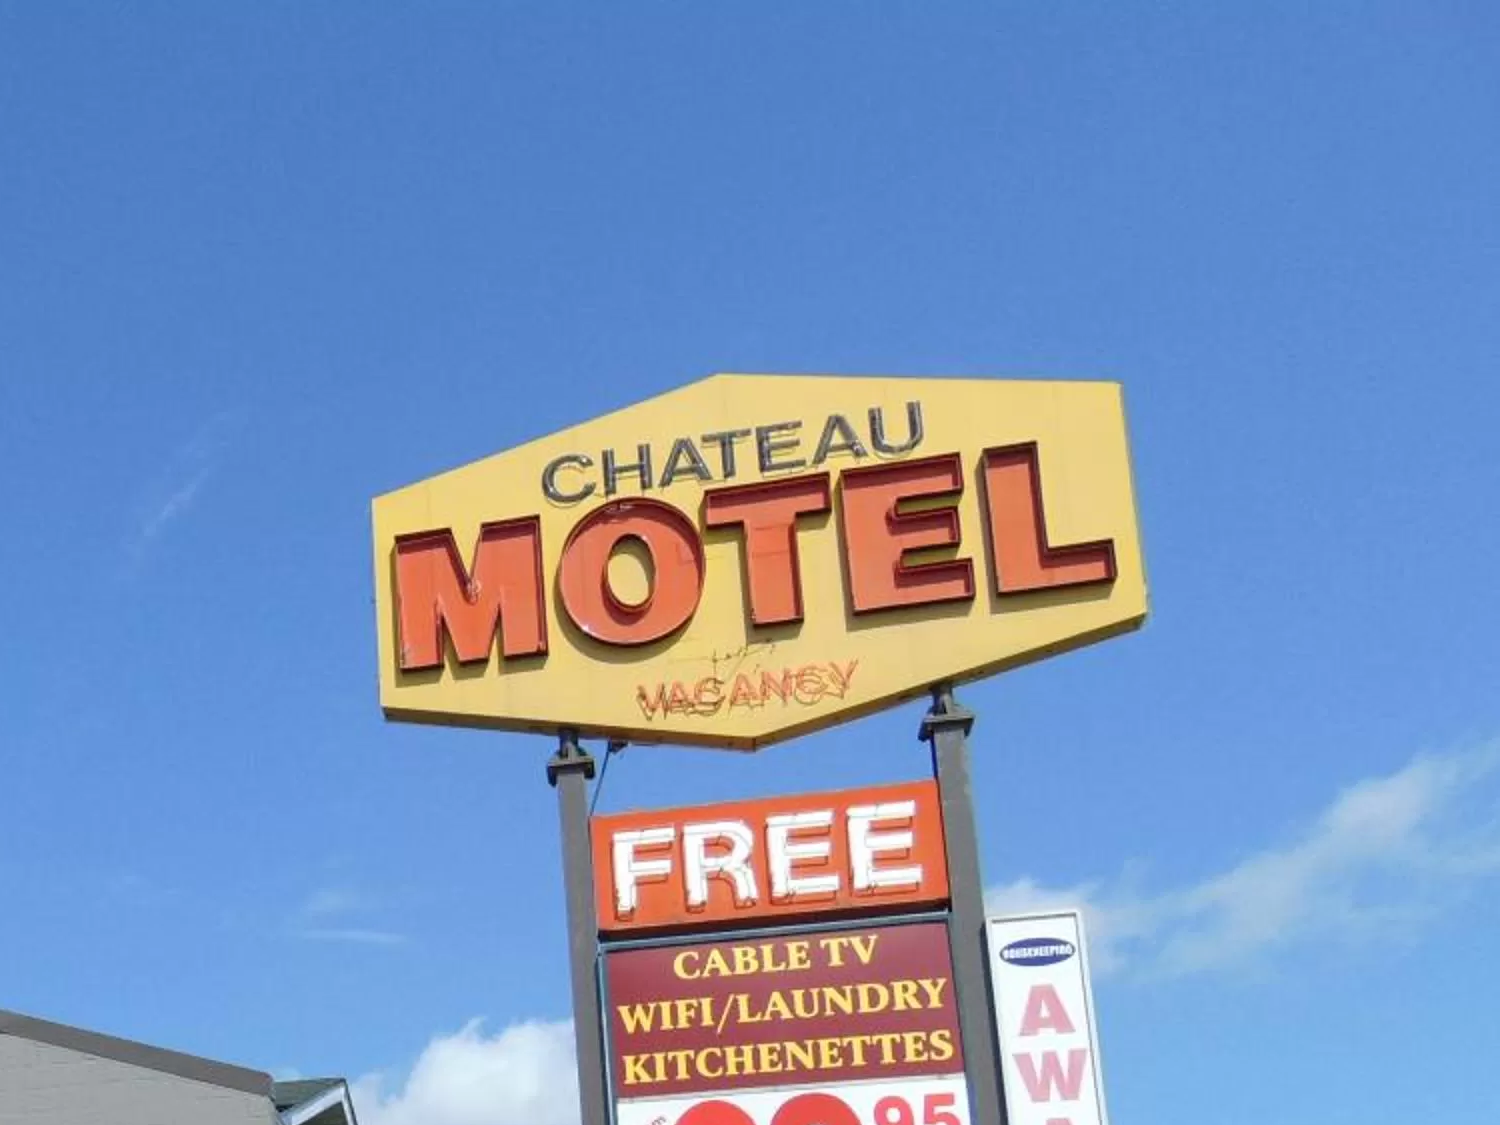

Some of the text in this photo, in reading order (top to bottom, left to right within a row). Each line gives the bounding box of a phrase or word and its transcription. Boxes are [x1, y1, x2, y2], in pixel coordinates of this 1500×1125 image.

[542, 400, 924, 503] CHATEAU
[394, 441, 1117, 673] MOTEL
[636, 659, 859, 721] VACANCY
[611, 800, 924, 920] FREE
[673, 935, 878, 980] CABLE TV
[617, 978, 947, 1035] WIFI/LAUNDRY
[622, 1029, 954, 1085] KITCHENETTES
